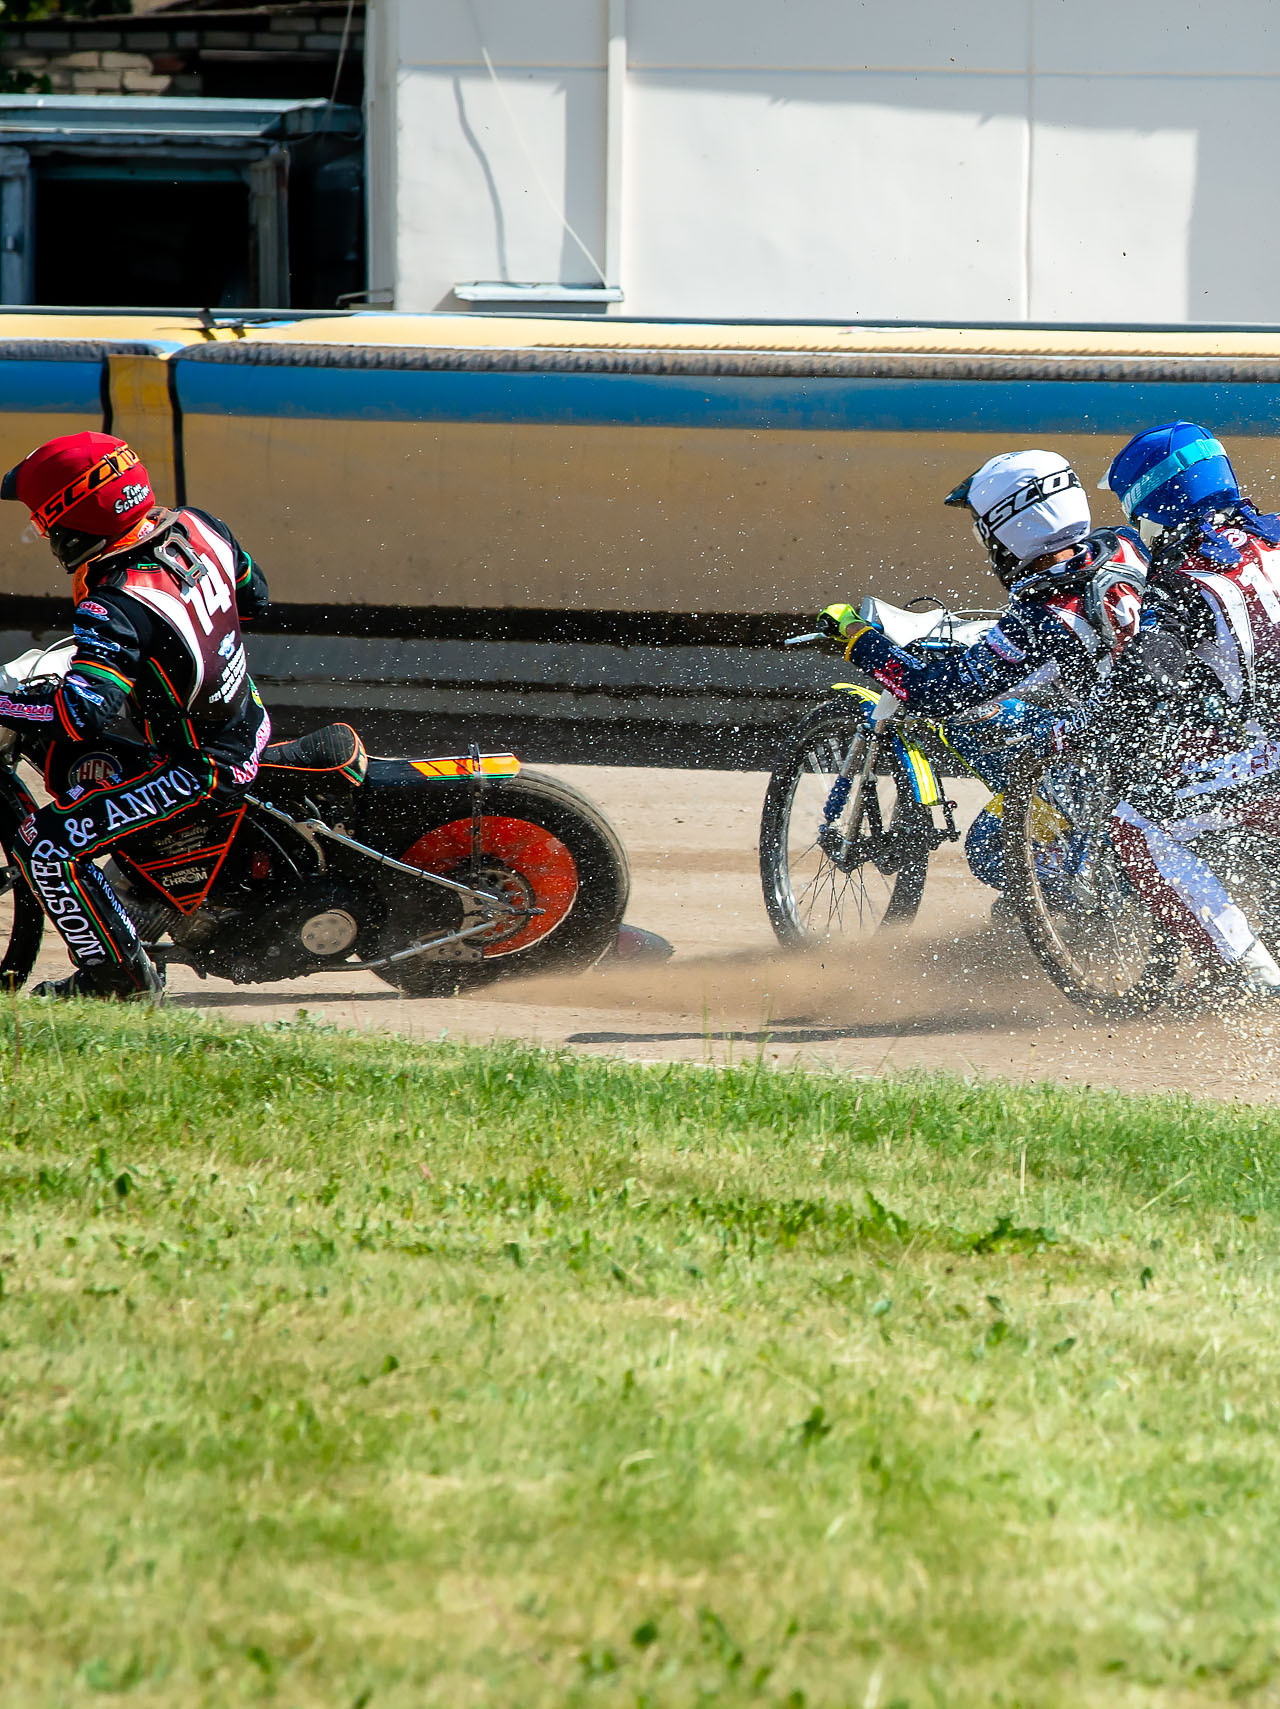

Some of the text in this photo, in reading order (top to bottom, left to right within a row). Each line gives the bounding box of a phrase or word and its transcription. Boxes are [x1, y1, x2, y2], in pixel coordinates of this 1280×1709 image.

[180, 553, 232, 636] 14
[64, 817, 98, 847] &
[162, 871, 209, 887] CHROM
